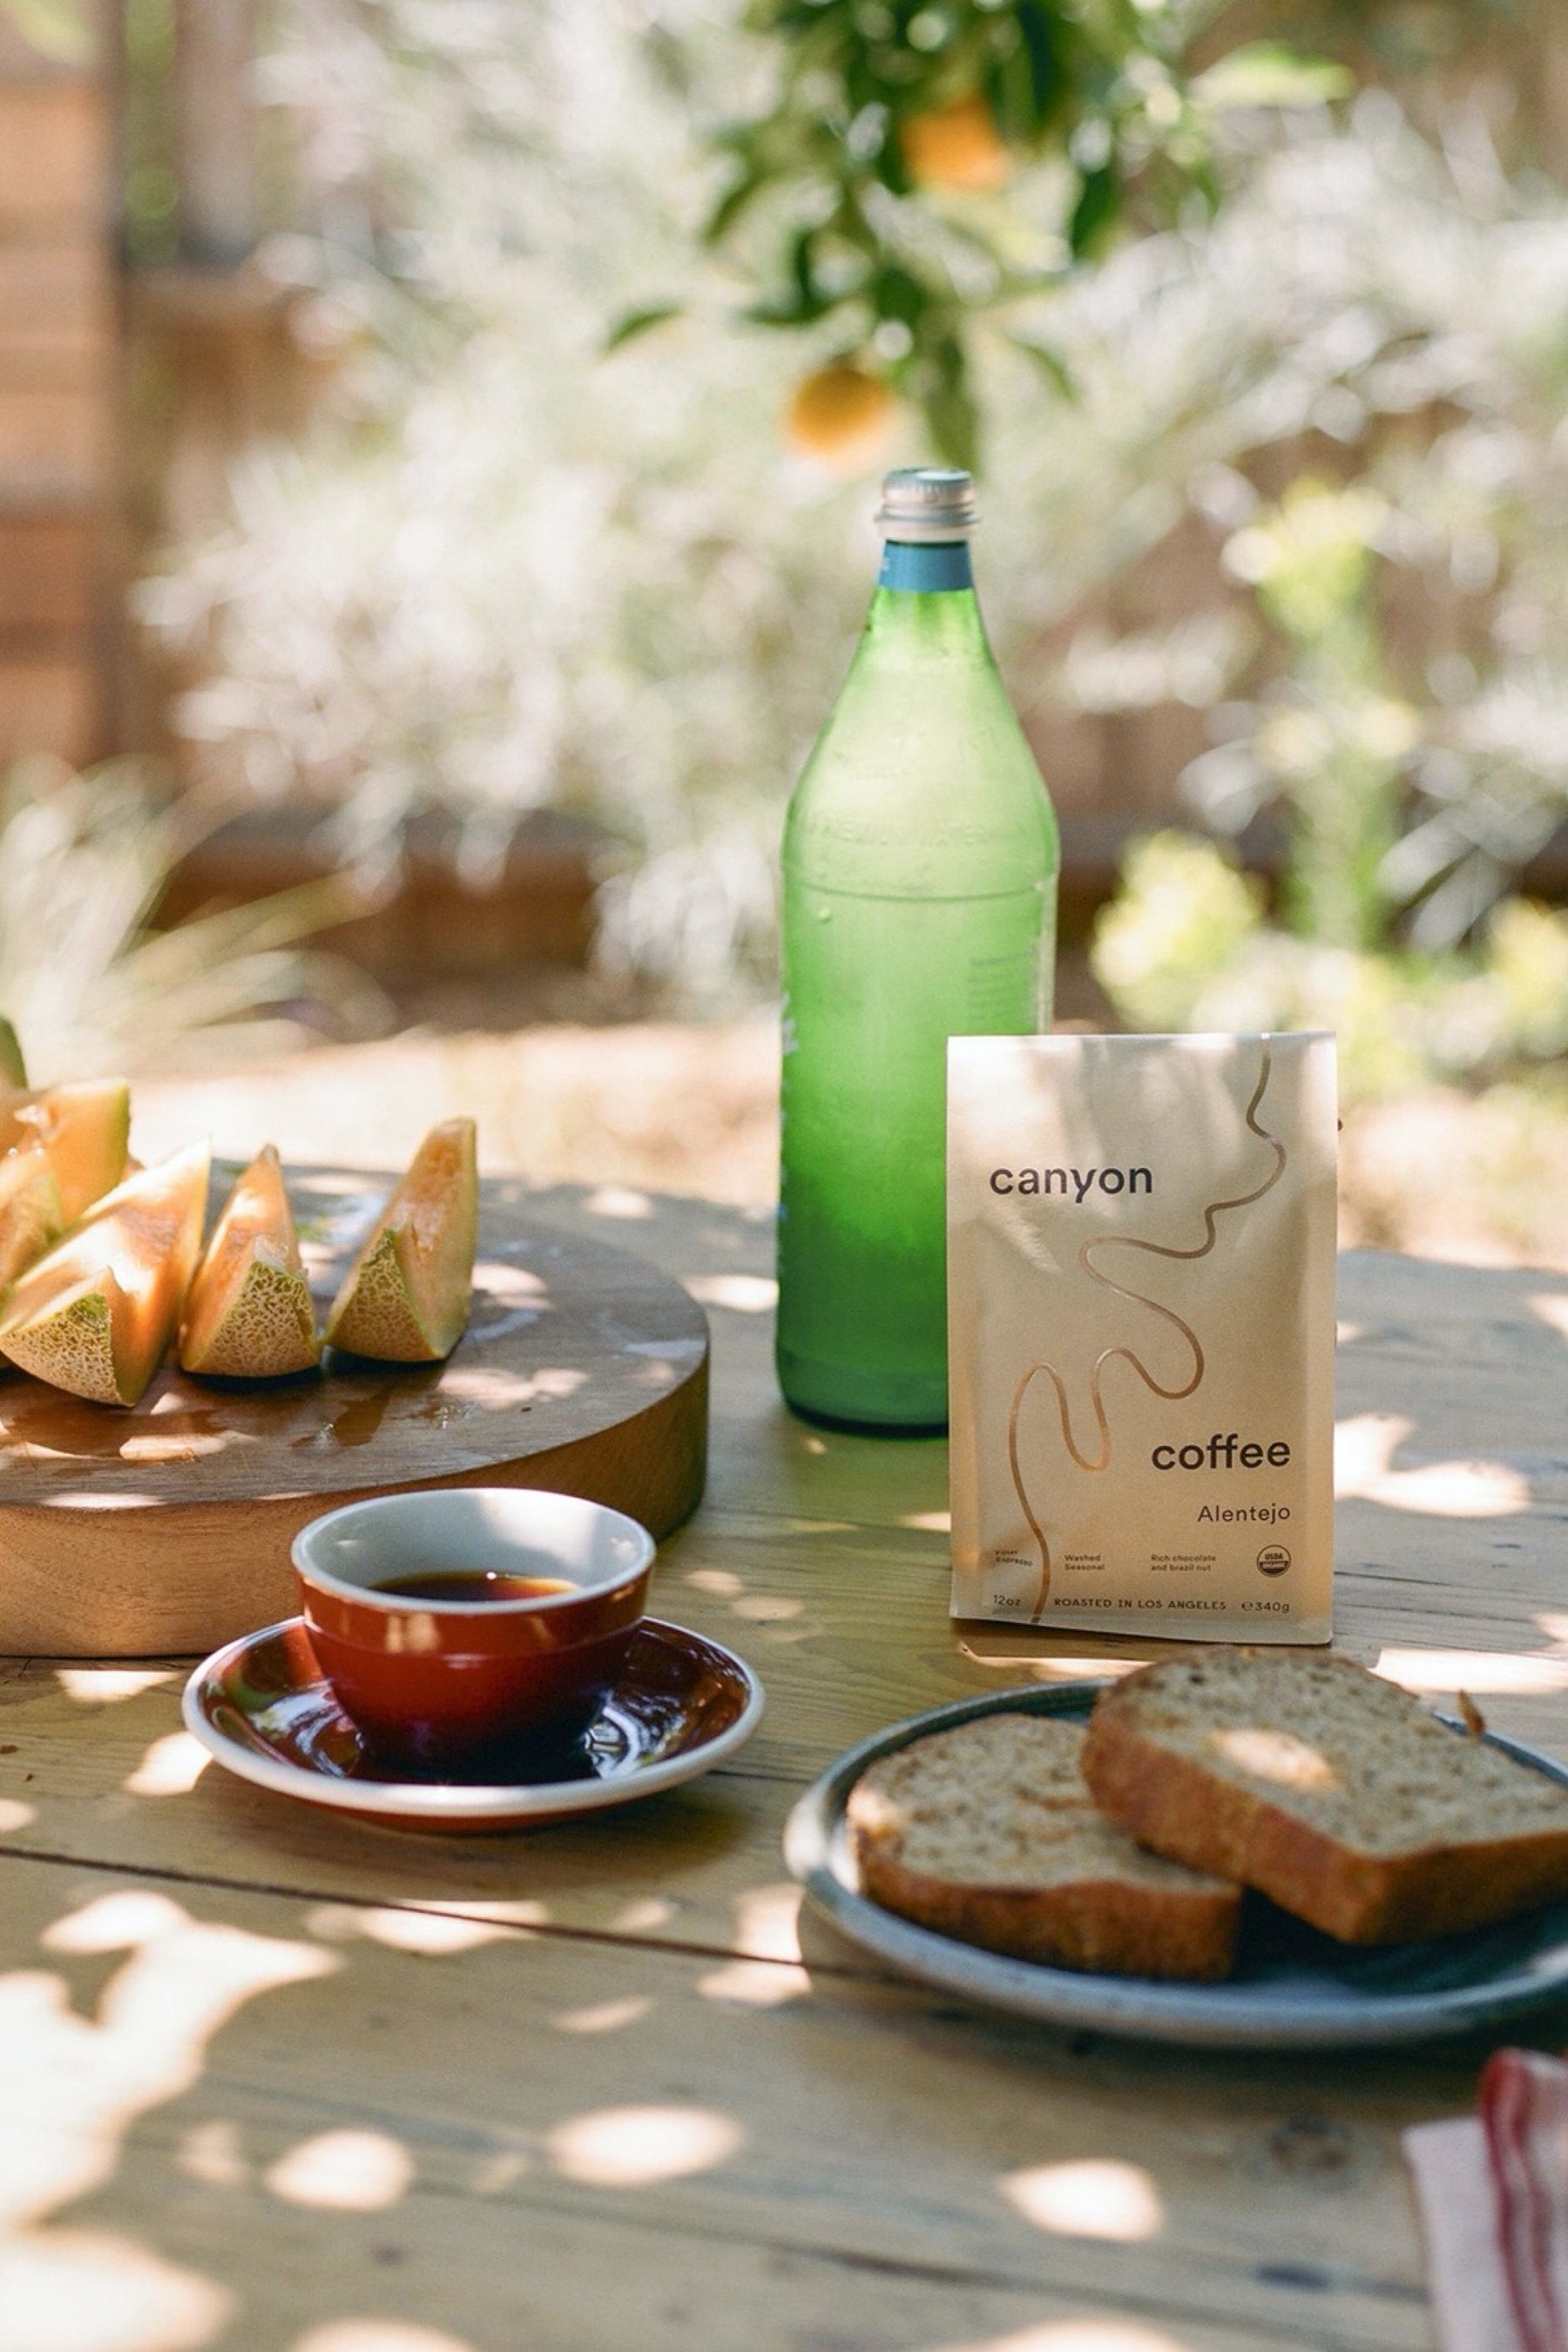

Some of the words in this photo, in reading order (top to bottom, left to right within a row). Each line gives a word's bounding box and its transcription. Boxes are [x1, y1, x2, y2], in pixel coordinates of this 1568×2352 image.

[990, 1167, 1152, 1204] canyon
[1152, 1433, 1290, 1470] coffee
[1197, 1503, 1290, 1524] Alentejo
[1064, 1553, 1101, 1562] Washed
[993, 1594, 1021, 1607] 12oz
[1054, 1598, 1112, 1609] ROASTED
[1118, 1598, 1132, 1609] IN
[1138, 1599, 1163, 1609] LOS
[1167, 1600, 1227, 1611] ANGELES
